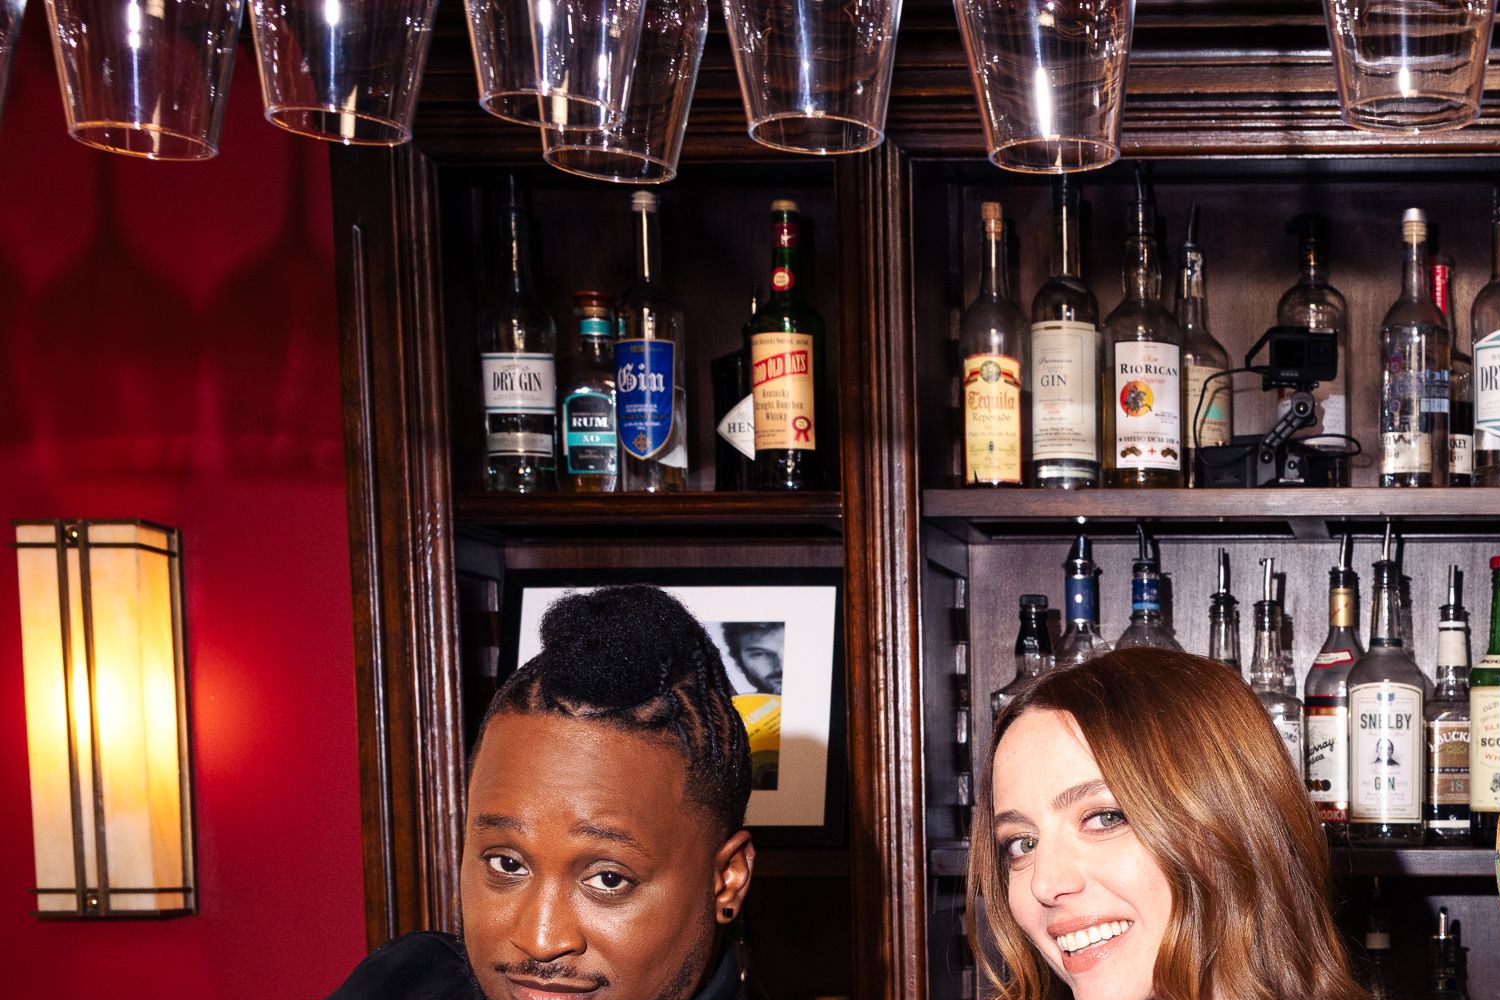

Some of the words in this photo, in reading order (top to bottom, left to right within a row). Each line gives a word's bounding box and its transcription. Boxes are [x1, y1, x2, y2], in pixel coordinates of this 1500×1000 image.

[768, 357, 784, 379] OLD
[785, 353, 807, 374] DAYS
[1120, 363, 1143, 375] RIO
[1145, 363, 1178, 377] RICAN
[493, 372, 515, 391] DRY
[519, 372, 541, 392] GIN
[617, 363, 665, 392] Gin
[1040, 375, 1067, 388] GIN
[967, 391, 1016, 413] Tequila
[572, 417, 609, 428] RUM
[583, 434, 600, 443] XO
[1374, 776, 1396, 791] GN
